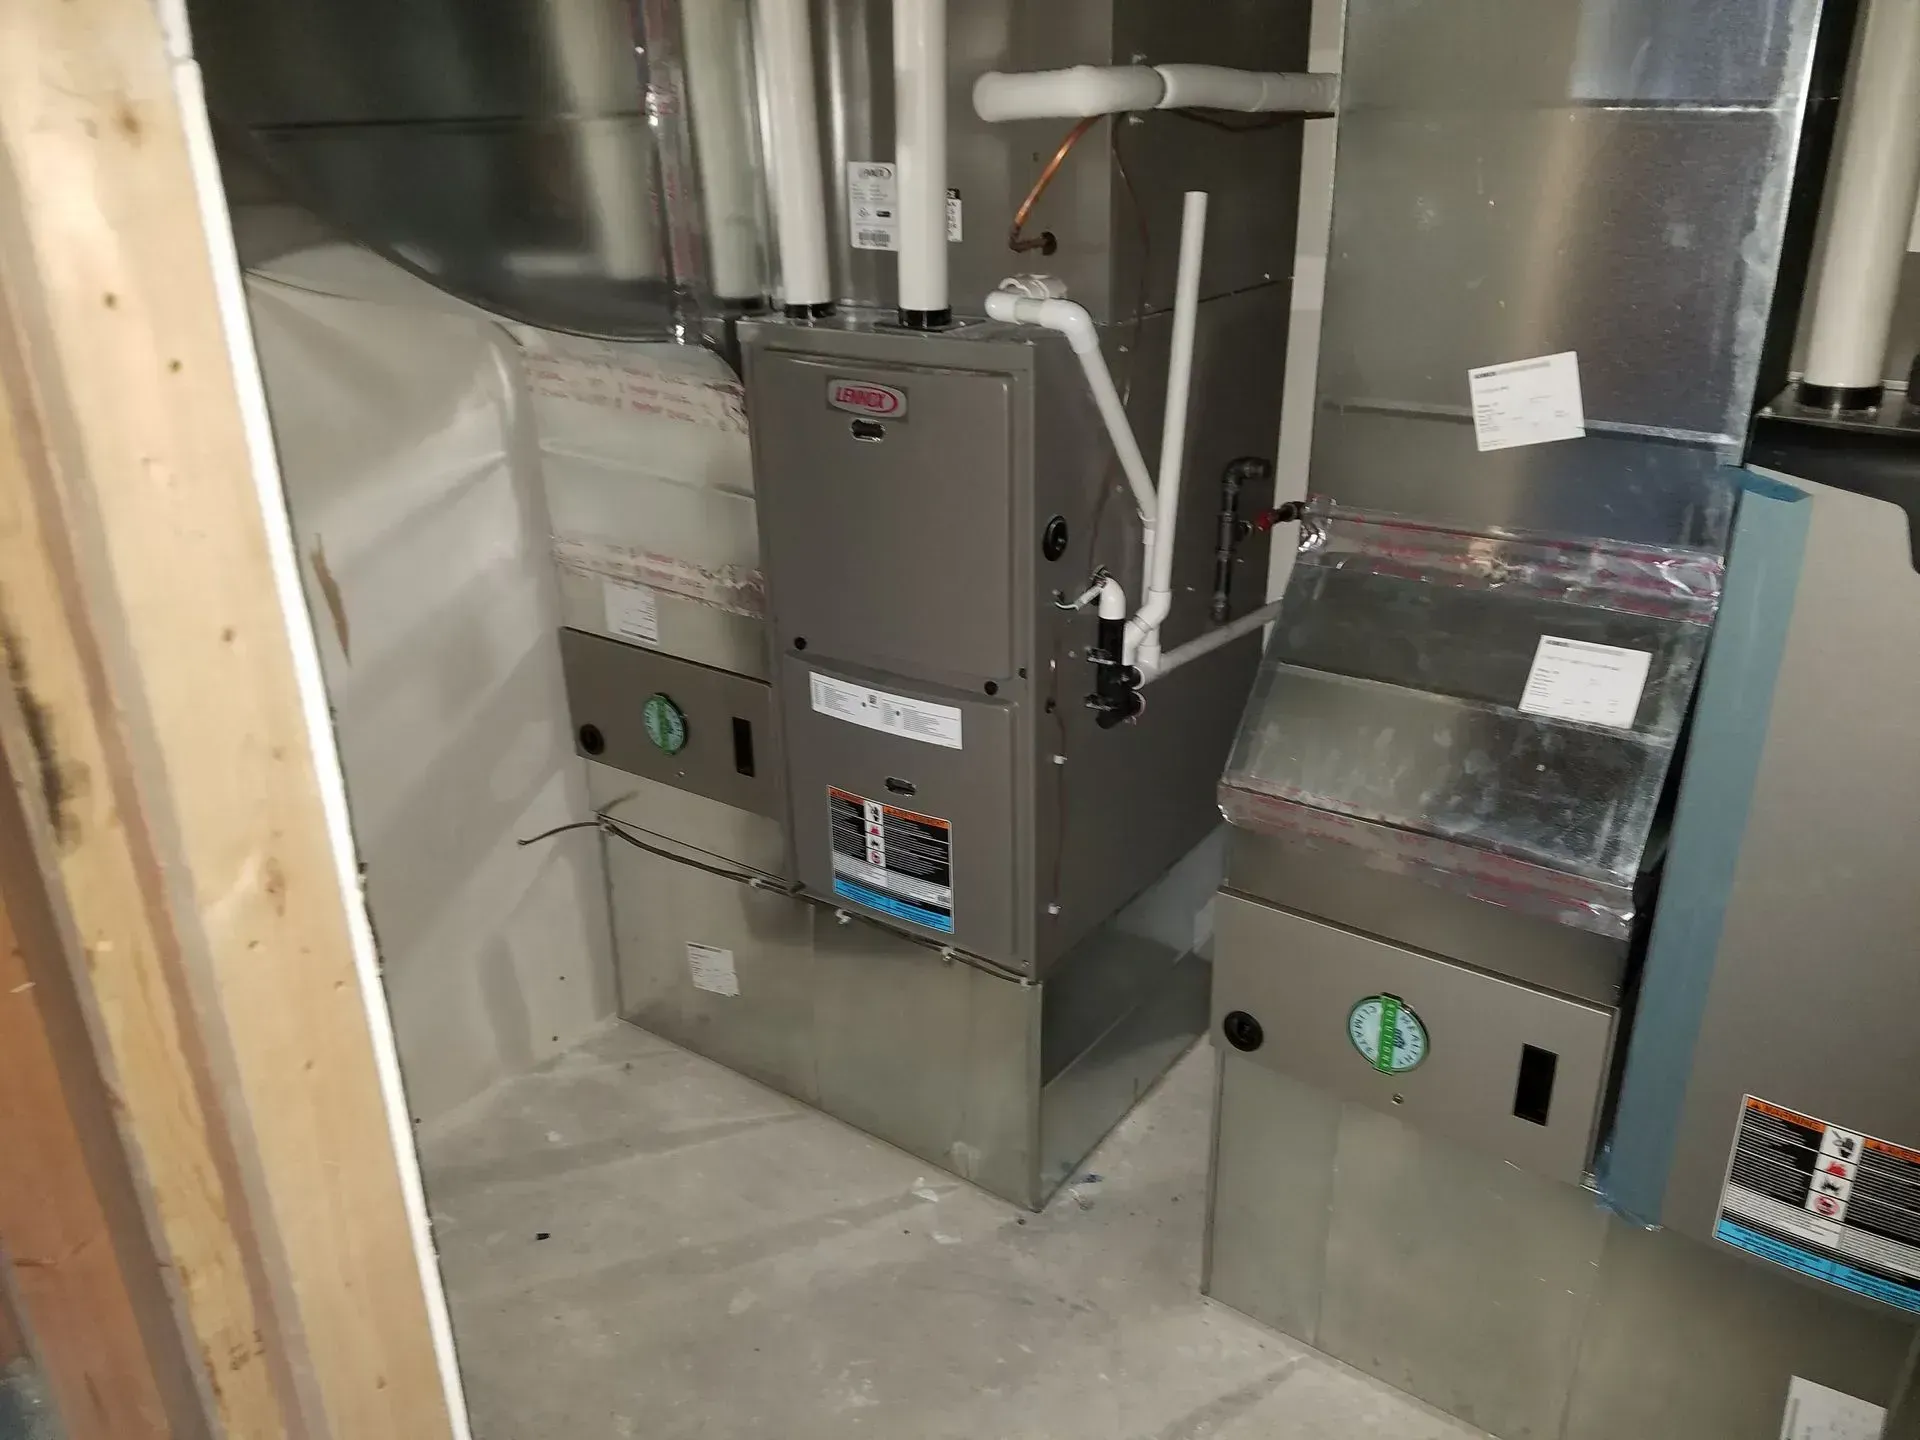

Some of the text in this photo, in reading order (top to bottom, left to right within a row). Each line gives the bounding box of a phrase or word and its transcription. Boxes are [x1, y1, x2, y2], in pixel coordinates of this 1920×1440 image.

[836, 386, 886, 409] LENNOX
[1353, 1005, 1377, 1054] CLIMATE
[1381, 1003, 1396, 1068] SOLUTIONS
